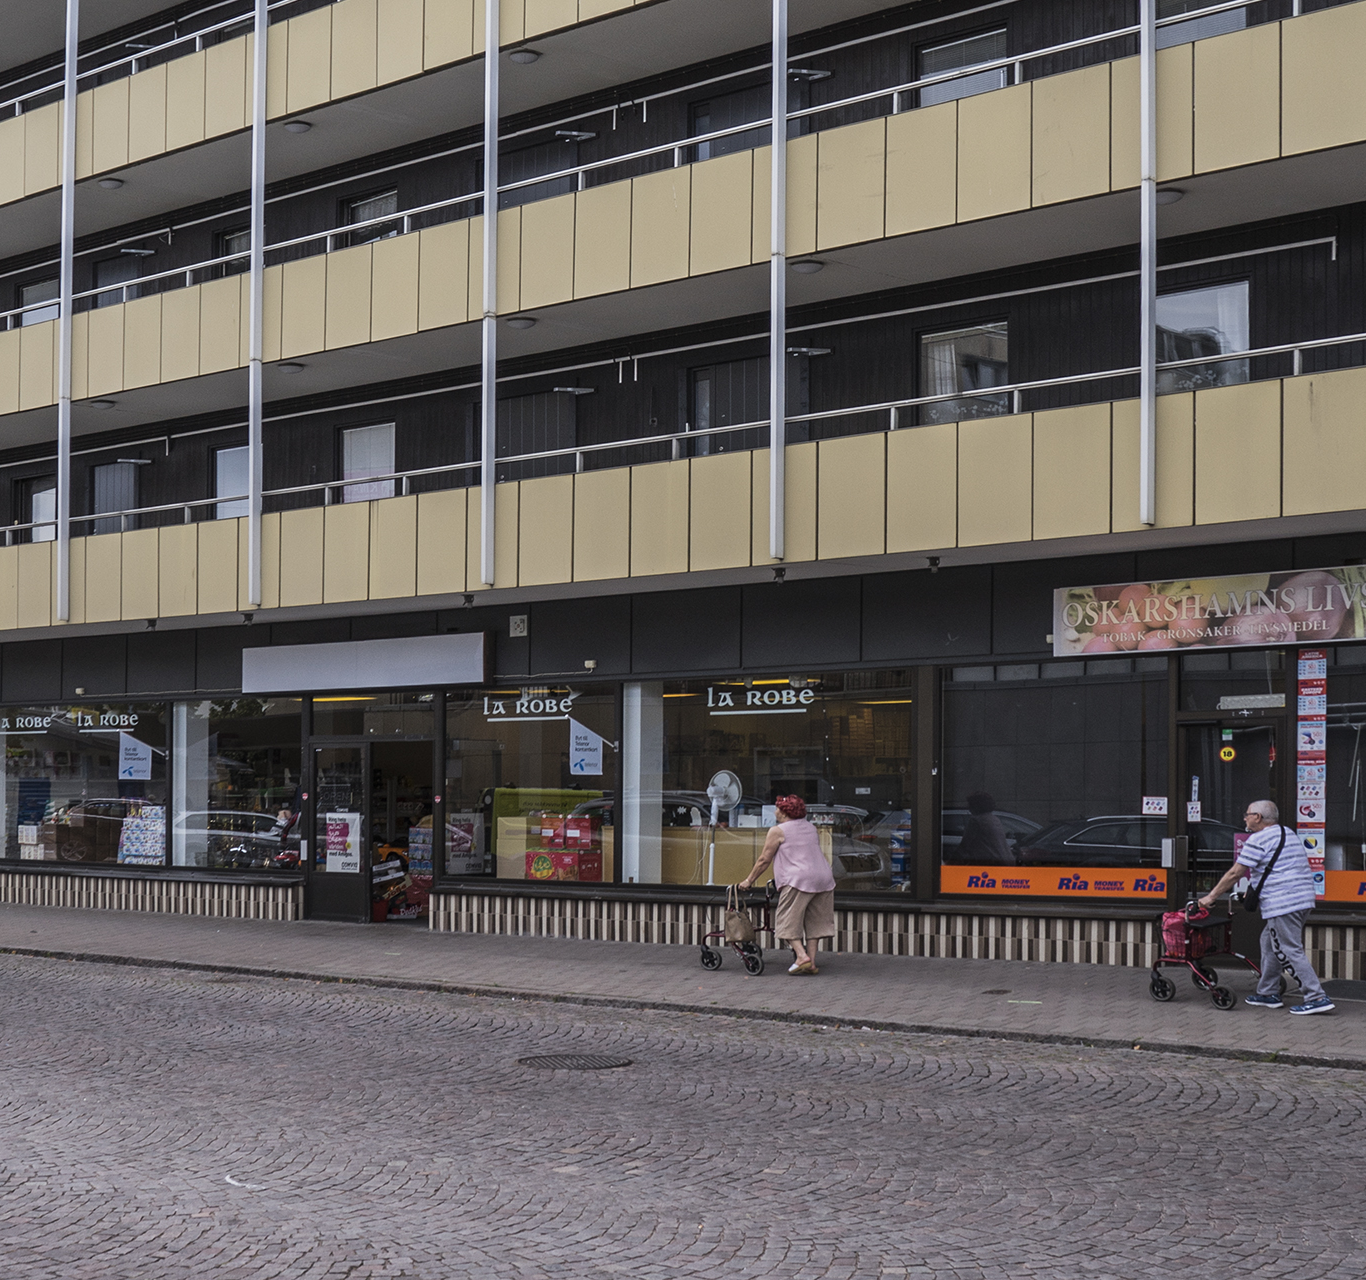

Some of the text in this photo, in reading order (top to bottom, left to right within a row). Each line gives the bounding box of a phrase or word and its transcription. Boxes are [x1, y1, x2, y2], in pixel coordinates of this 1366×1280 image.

[1062, 586, 1296, 628] OSKARSHAMNS
[1101, 619, 1330, 644] TOBAK GRÖNSAKER LIVSMEDEL
[967, 871, 996, 888] Ria
[1057, 873, 1089, 890] Ria
[1133, 874, 1165, 892] Ria
